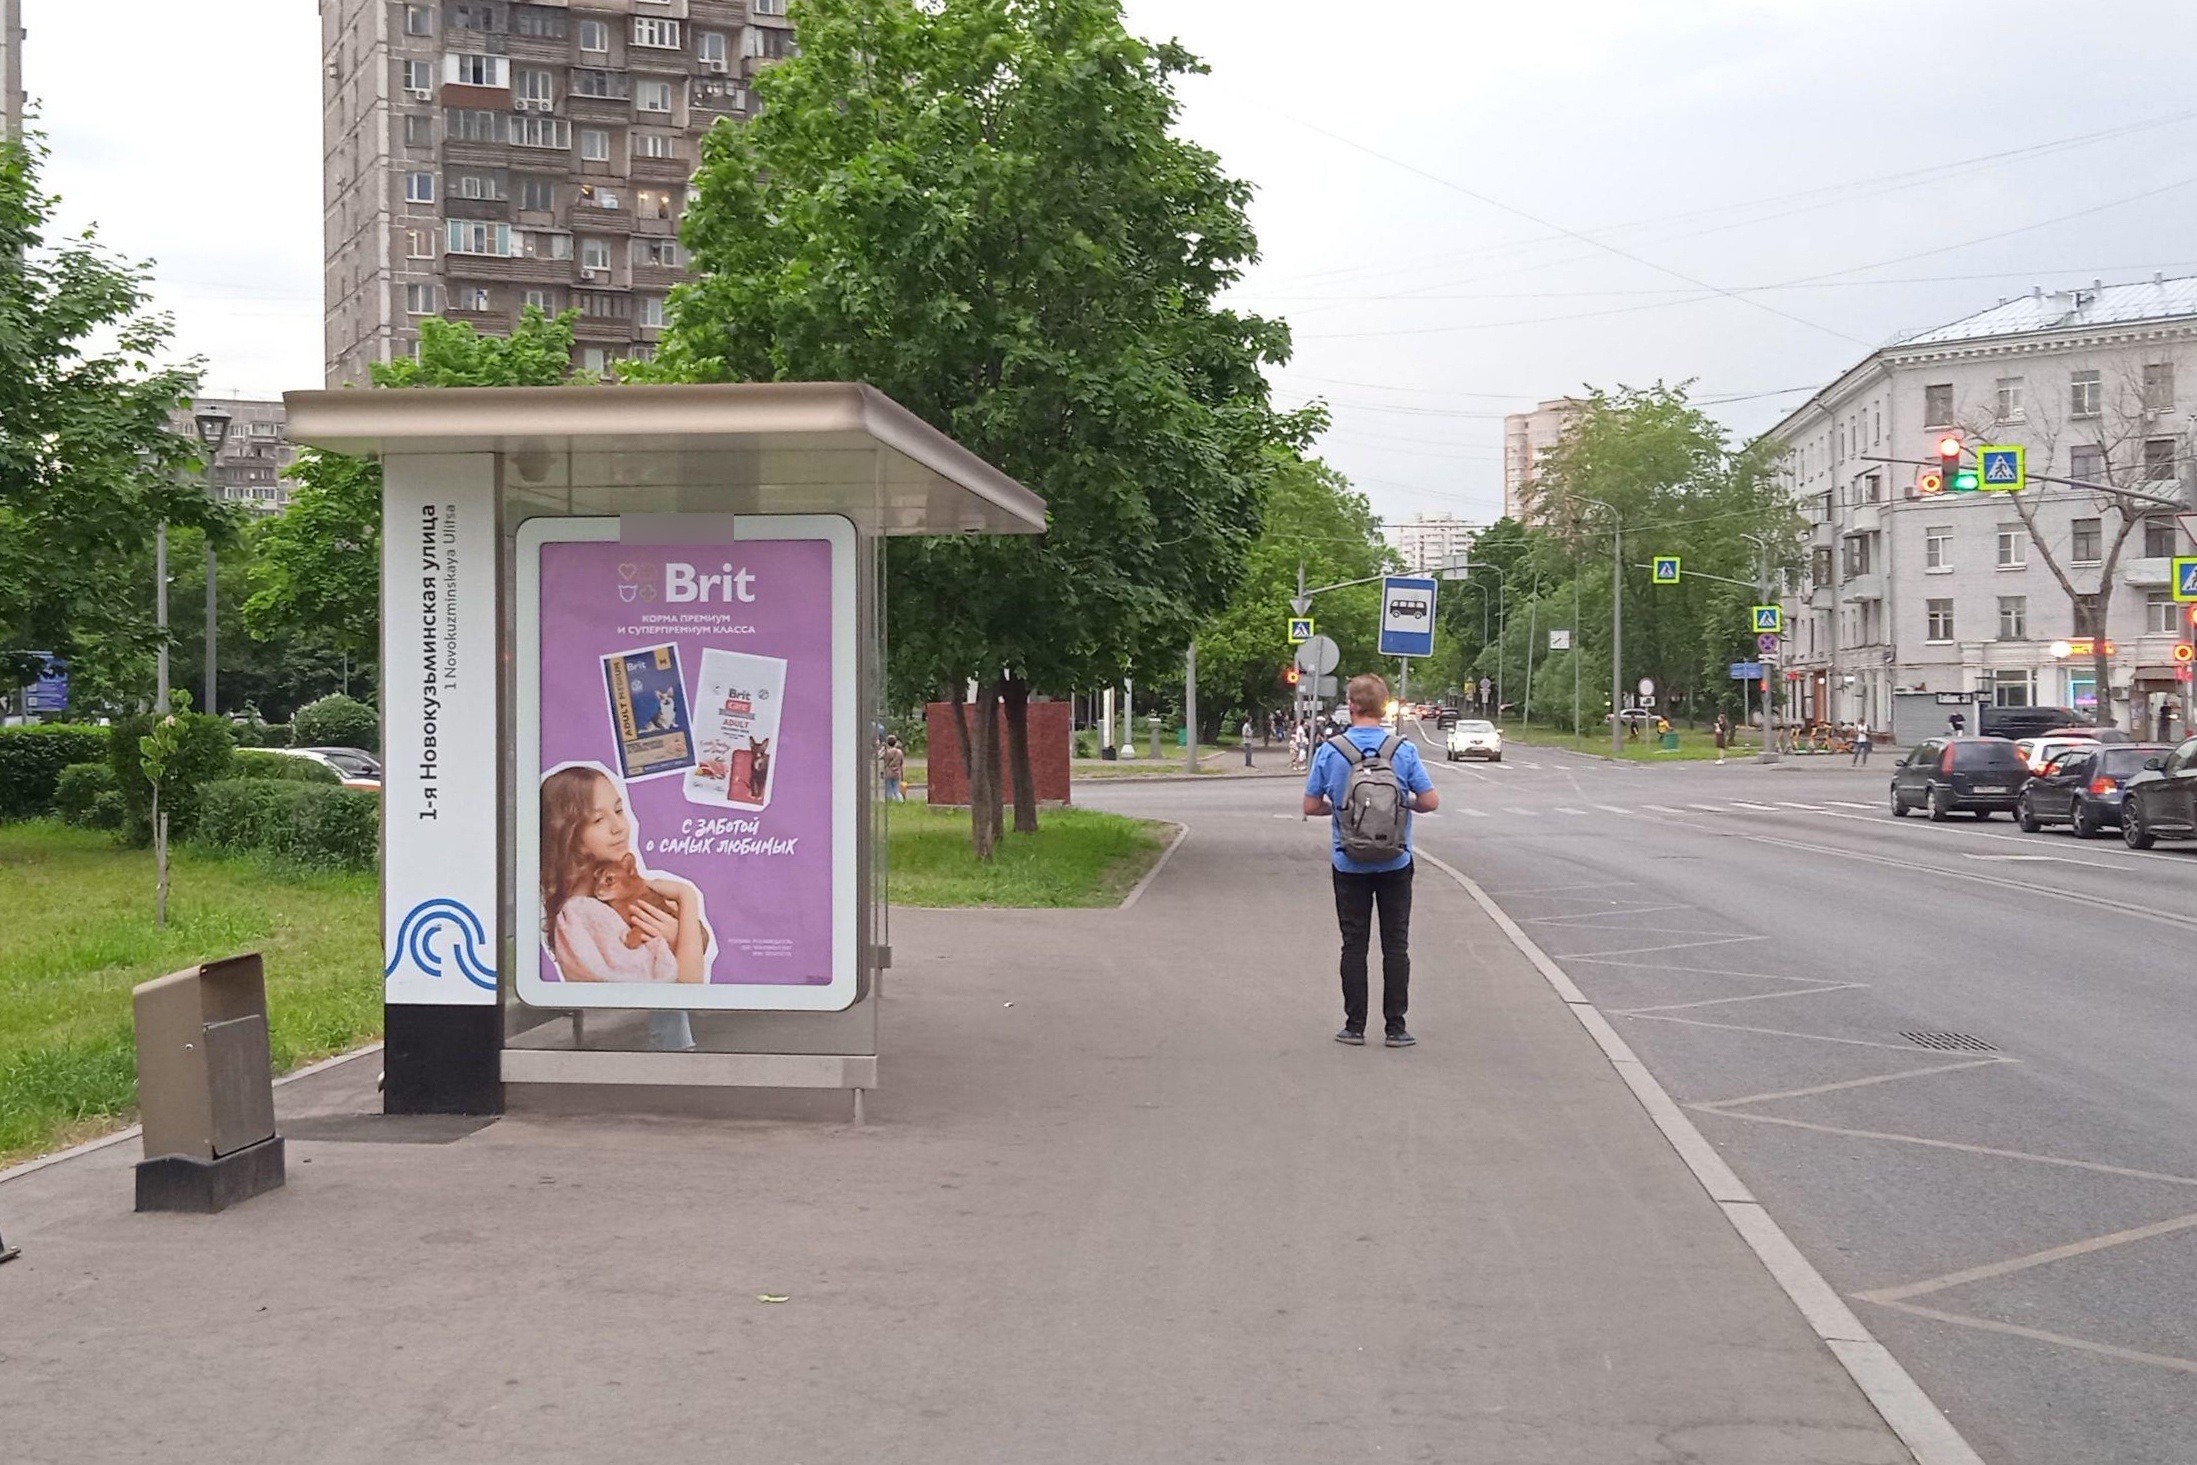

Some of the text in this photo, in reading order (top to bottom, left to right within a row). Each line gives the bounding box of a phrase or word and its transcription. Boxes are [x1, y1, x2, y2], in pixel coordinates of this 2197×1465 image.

[665, 562, 756, 603] Brit
[443, 504, 458, 690] 1 Novokuzminskaya Ulitsa
[642, 614, 731, 624] КОРМА ПРЕМИУМ
[617, 625, 756, 636] И СУПЕРПРЕМИУМ КЛАССА
[419, 504, 440, 820] 1-я Новокузьминская улица
[626, 661, 646, 672] Brit
[613, 662, 632, 736] ADULT MEDIUM
[728, 688, 752, 701] Brit
[723, 719, 750, 729] ADULT
[659, 836, 715, 855] САМЫХ
[716, 836, 799, 856] ЛЮБИМЫХ
